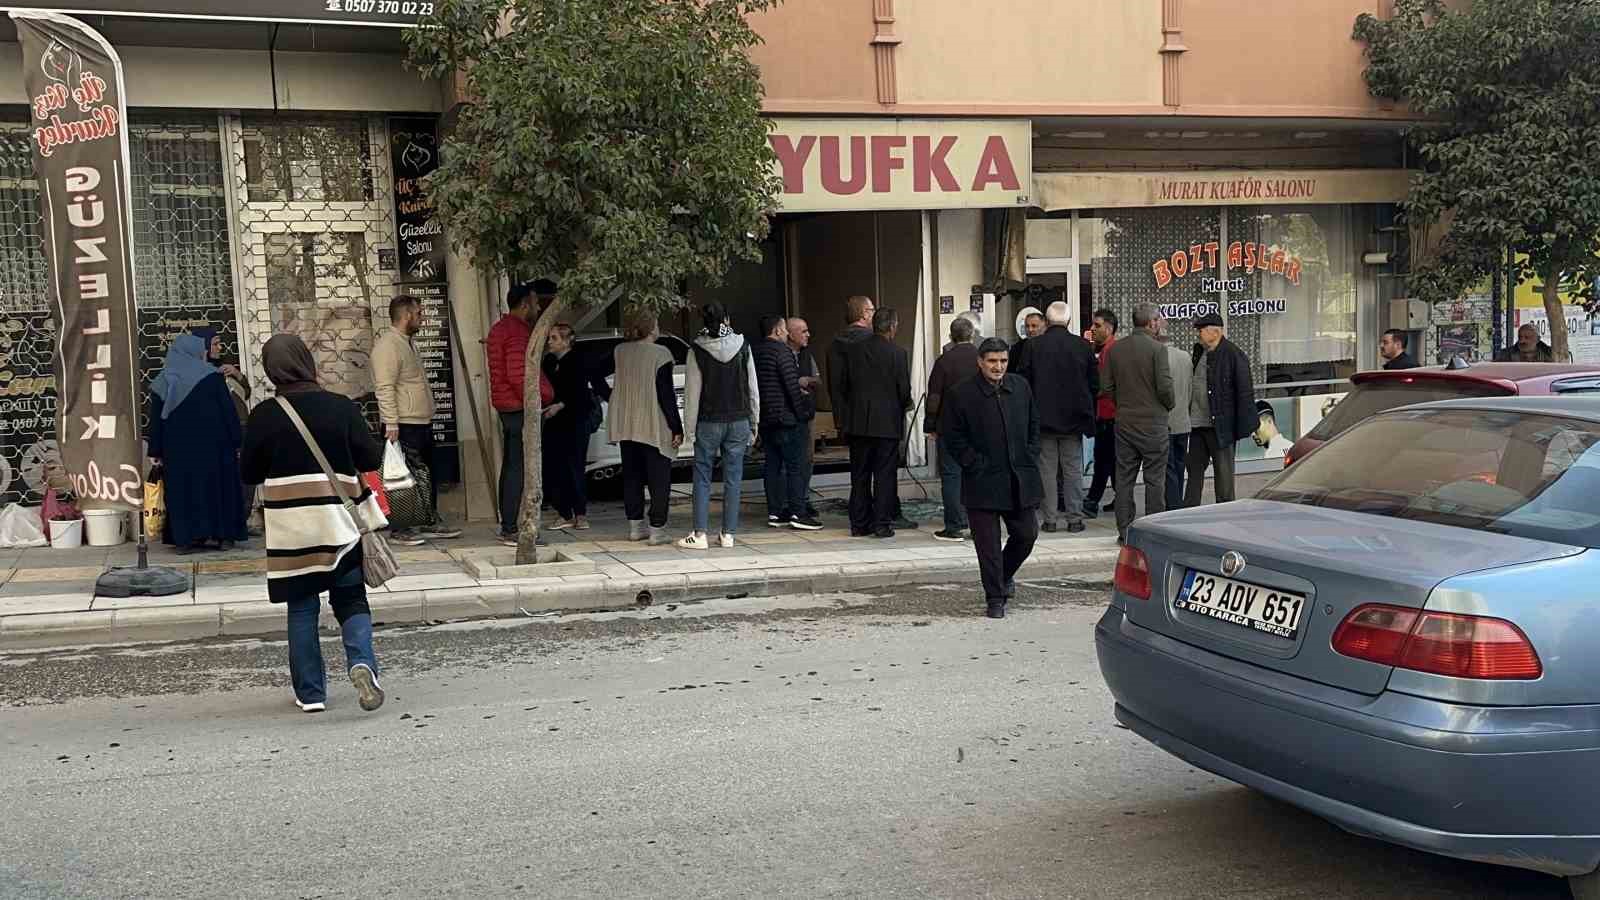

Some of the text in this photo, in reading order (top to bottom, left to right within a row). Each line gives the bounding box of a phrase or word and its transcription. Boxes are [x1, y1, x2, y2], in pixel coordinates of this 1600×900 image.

[345, 0, 434, 15] 0507 370 02 23
[768, 134, 1021, 196] YUFKA
[1160, 177, 1317, 200] MURAT KUAFÖR SALONU
[1202, 278, 1244, 292] Murat
[1229, 298, 1287, 317] SALONU
[1190, 576, 1301, 628] 23 ADV 651
[1189, 603, 1249, 626] OTO KARACA
